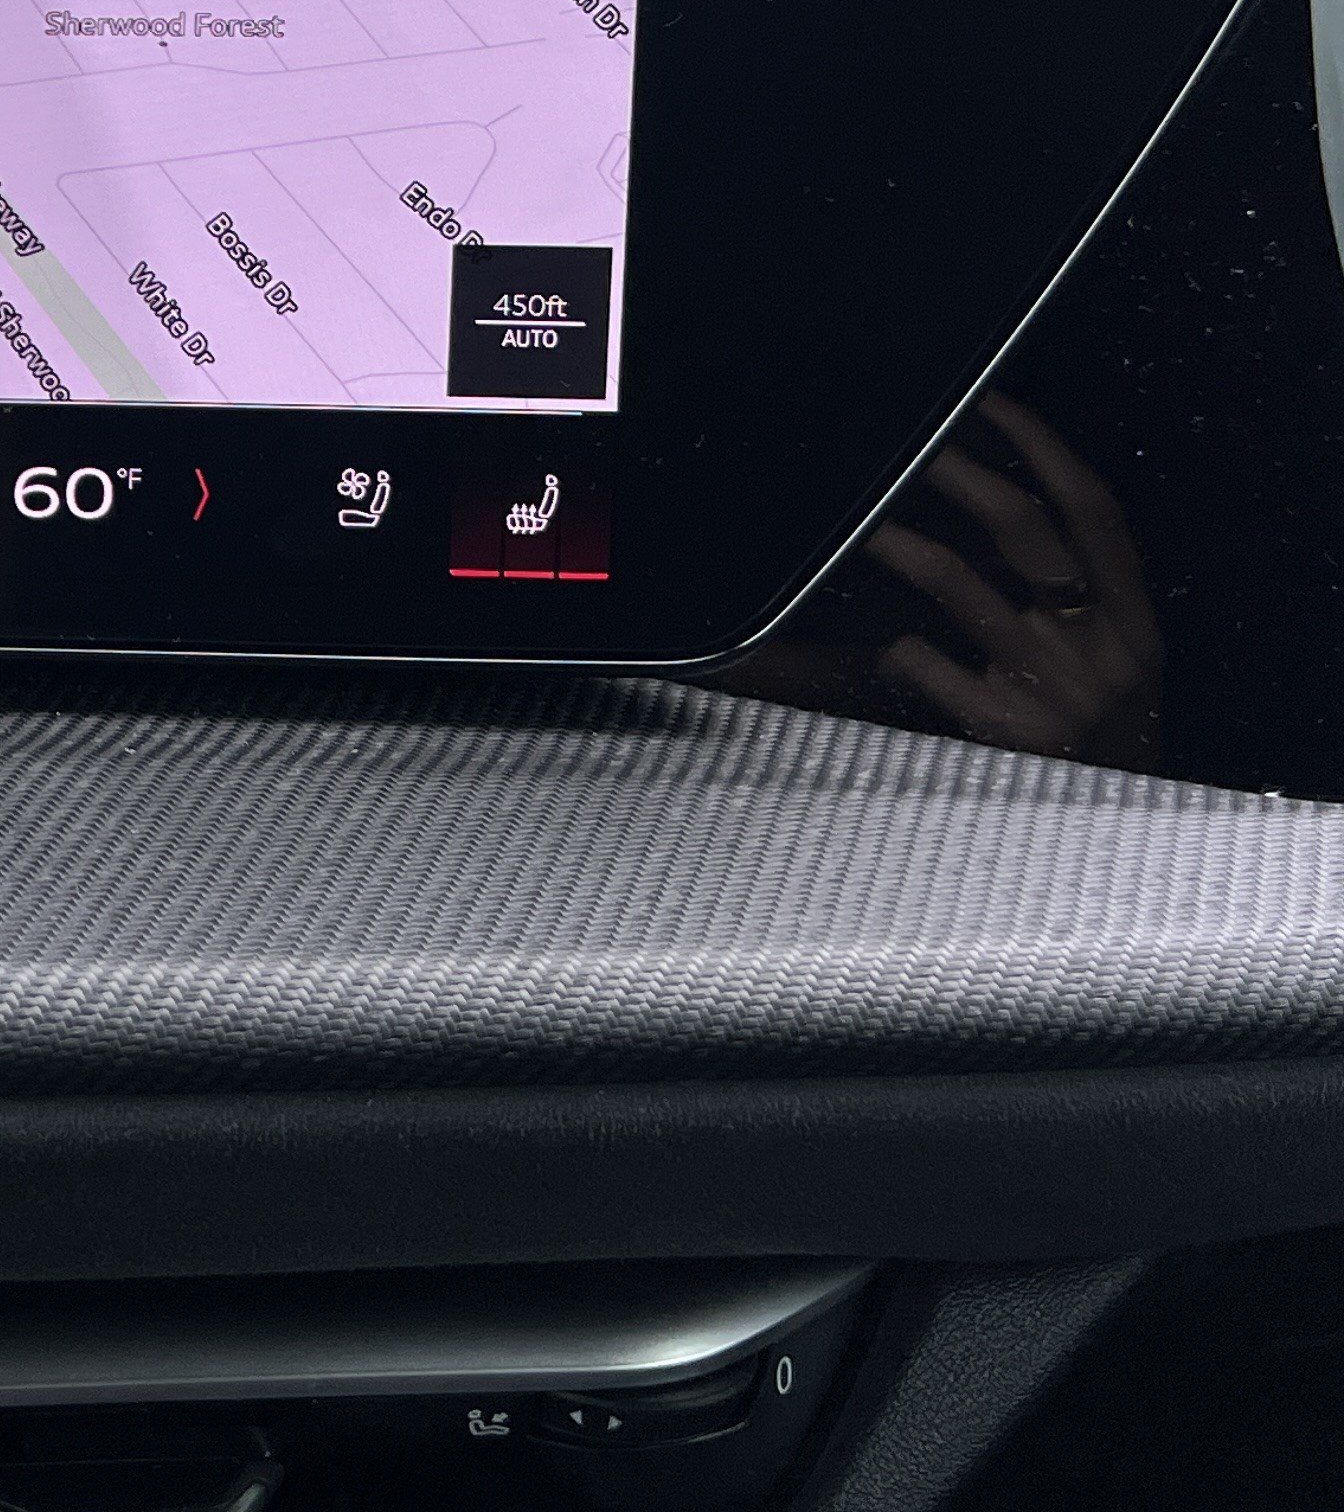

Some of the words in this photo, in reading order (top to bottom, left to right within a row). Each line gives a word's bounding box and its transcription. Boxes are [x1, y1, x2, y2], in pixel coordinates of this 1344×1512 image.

[44, 11, 186, 37] Sherwood
[193, 12, 286, 39] Forest
[592, 4, 629, 40] Dr
[399, 181, 461, 239] Endo
[206, 212, 271, 289] Bossis
[264, 280, 298, 316] Dr
[128, 261, 190, 338] White
[181, 331, 215, 369] Dr
[492, 293, 568, 318] 450ft
[500, 329, 559, 348] AUTO
